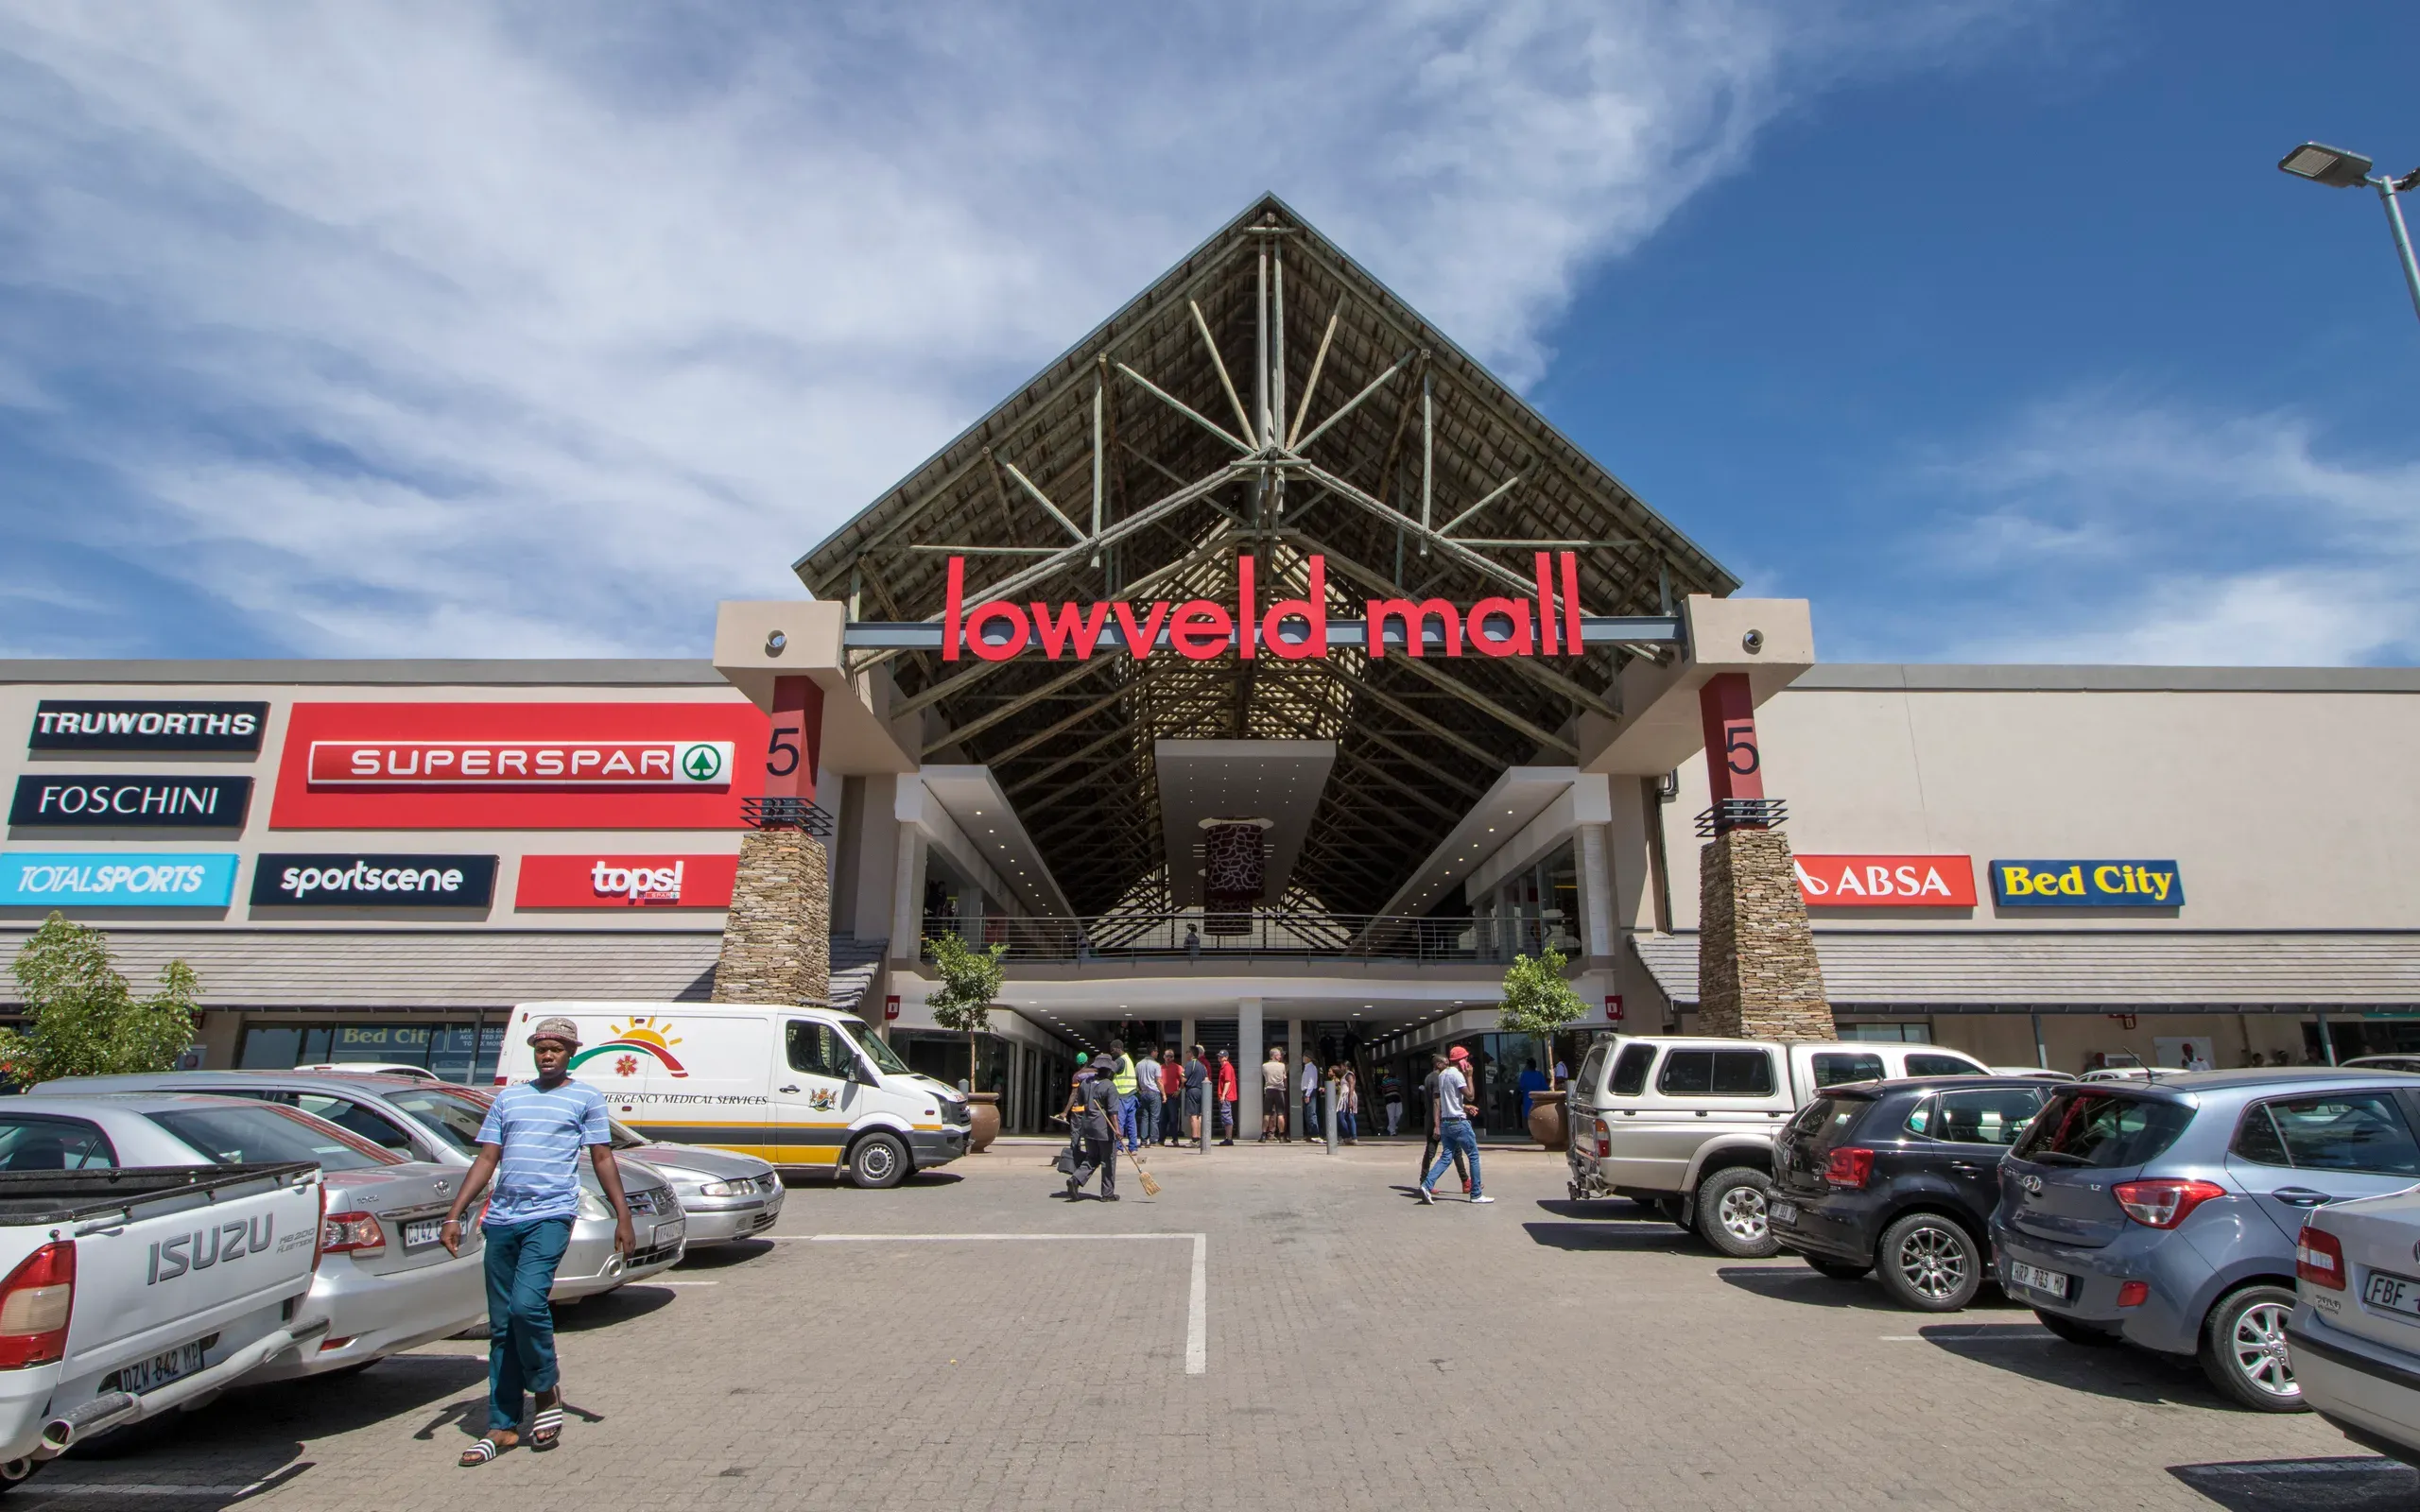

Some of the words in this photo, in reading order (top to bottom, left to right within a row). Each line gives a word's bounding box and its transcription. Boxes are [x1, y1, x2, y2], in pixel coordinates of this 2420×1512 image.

[942, 554, 1325, 662] lowveld
[1367, 551, 1584, 658] mall
[38, 712, 257, 735] TRUWORTHS
[350, 749, 670, 776] SUPERSPAR
[766, 727, 800, 777] 5
[1726, 726, 1760, 776] 5
[38, 785, 219, 815] FOSCHINI
[17, 864, 206, 893] TOTALSPORTS
[281, 860, 463, 899] sportscene
[591, 860, 684, 900] tops!
[1835, 865, 1952, 897] ABSA
[2001, 866, 2086, 896] Bed
[2093, 865, 2173, 901] City
[342, 1027, 388, 1044] Bed
[394, 1028, 439, 1047] City
[662, 1094, 713, 1105] MEDICAL
[716, 1095, 769, 1106] SERVICES
[147, 1211, 274, 1286] ISUZU
[2371, 1278, 2407, 1306] FBF
[183, 1342, 199, 1370] MP
